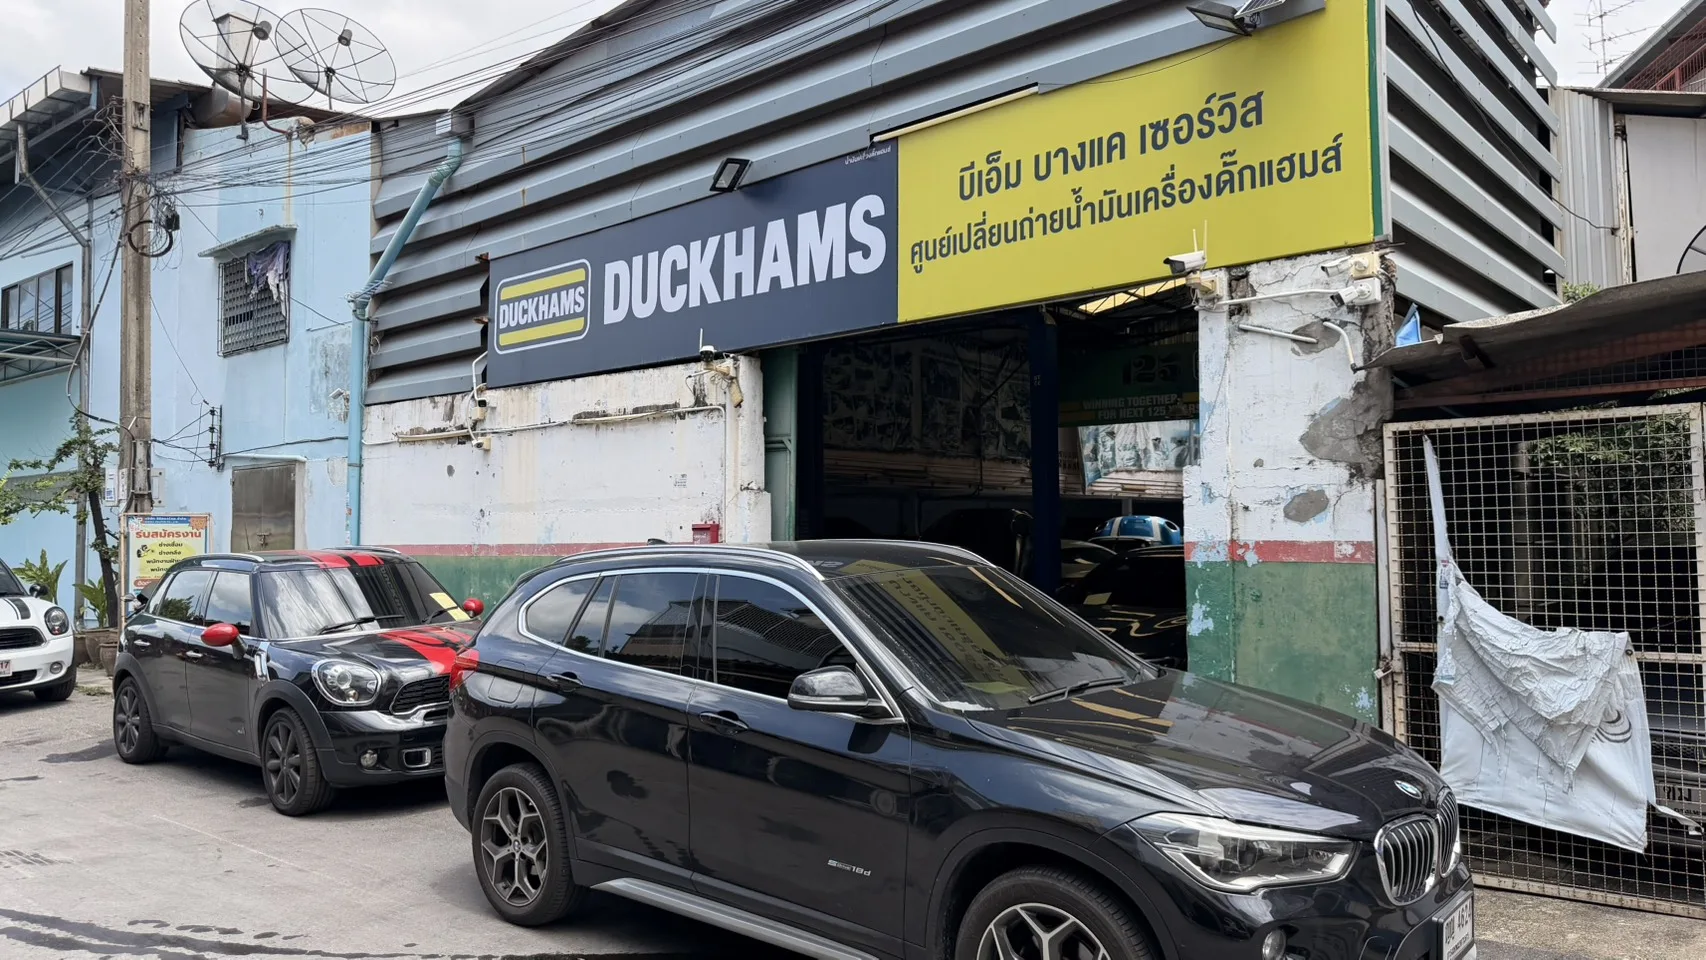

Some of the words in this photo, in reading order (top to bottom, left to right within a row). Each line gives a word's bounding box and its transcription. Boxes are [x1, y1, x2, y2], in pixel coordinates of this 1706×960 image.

[959, 150, 1022, 201] บีเอ็ม
[1034, 131, 1126, 181] บางแค
[1139, 90, 1264, 155] เซอร์วิส
[911, 132, 1343, 274] ศูนย์เปลี่ยนถ่ายน้ำมันเครื่องดั๊กแฮมส์
[603, 194, 886, 325] DUCKHAMS
[499, 286, 585, 330] DUCKHAMS
[1082, 397, 1125, 410] WINNING
[1098, 408, 1117, 421] FOR
[1119, 407, 1145, 420] NEXT
[1148, 405, 1166, 417] 125
[135, 529, 202, 538] รับสมัครงาน
